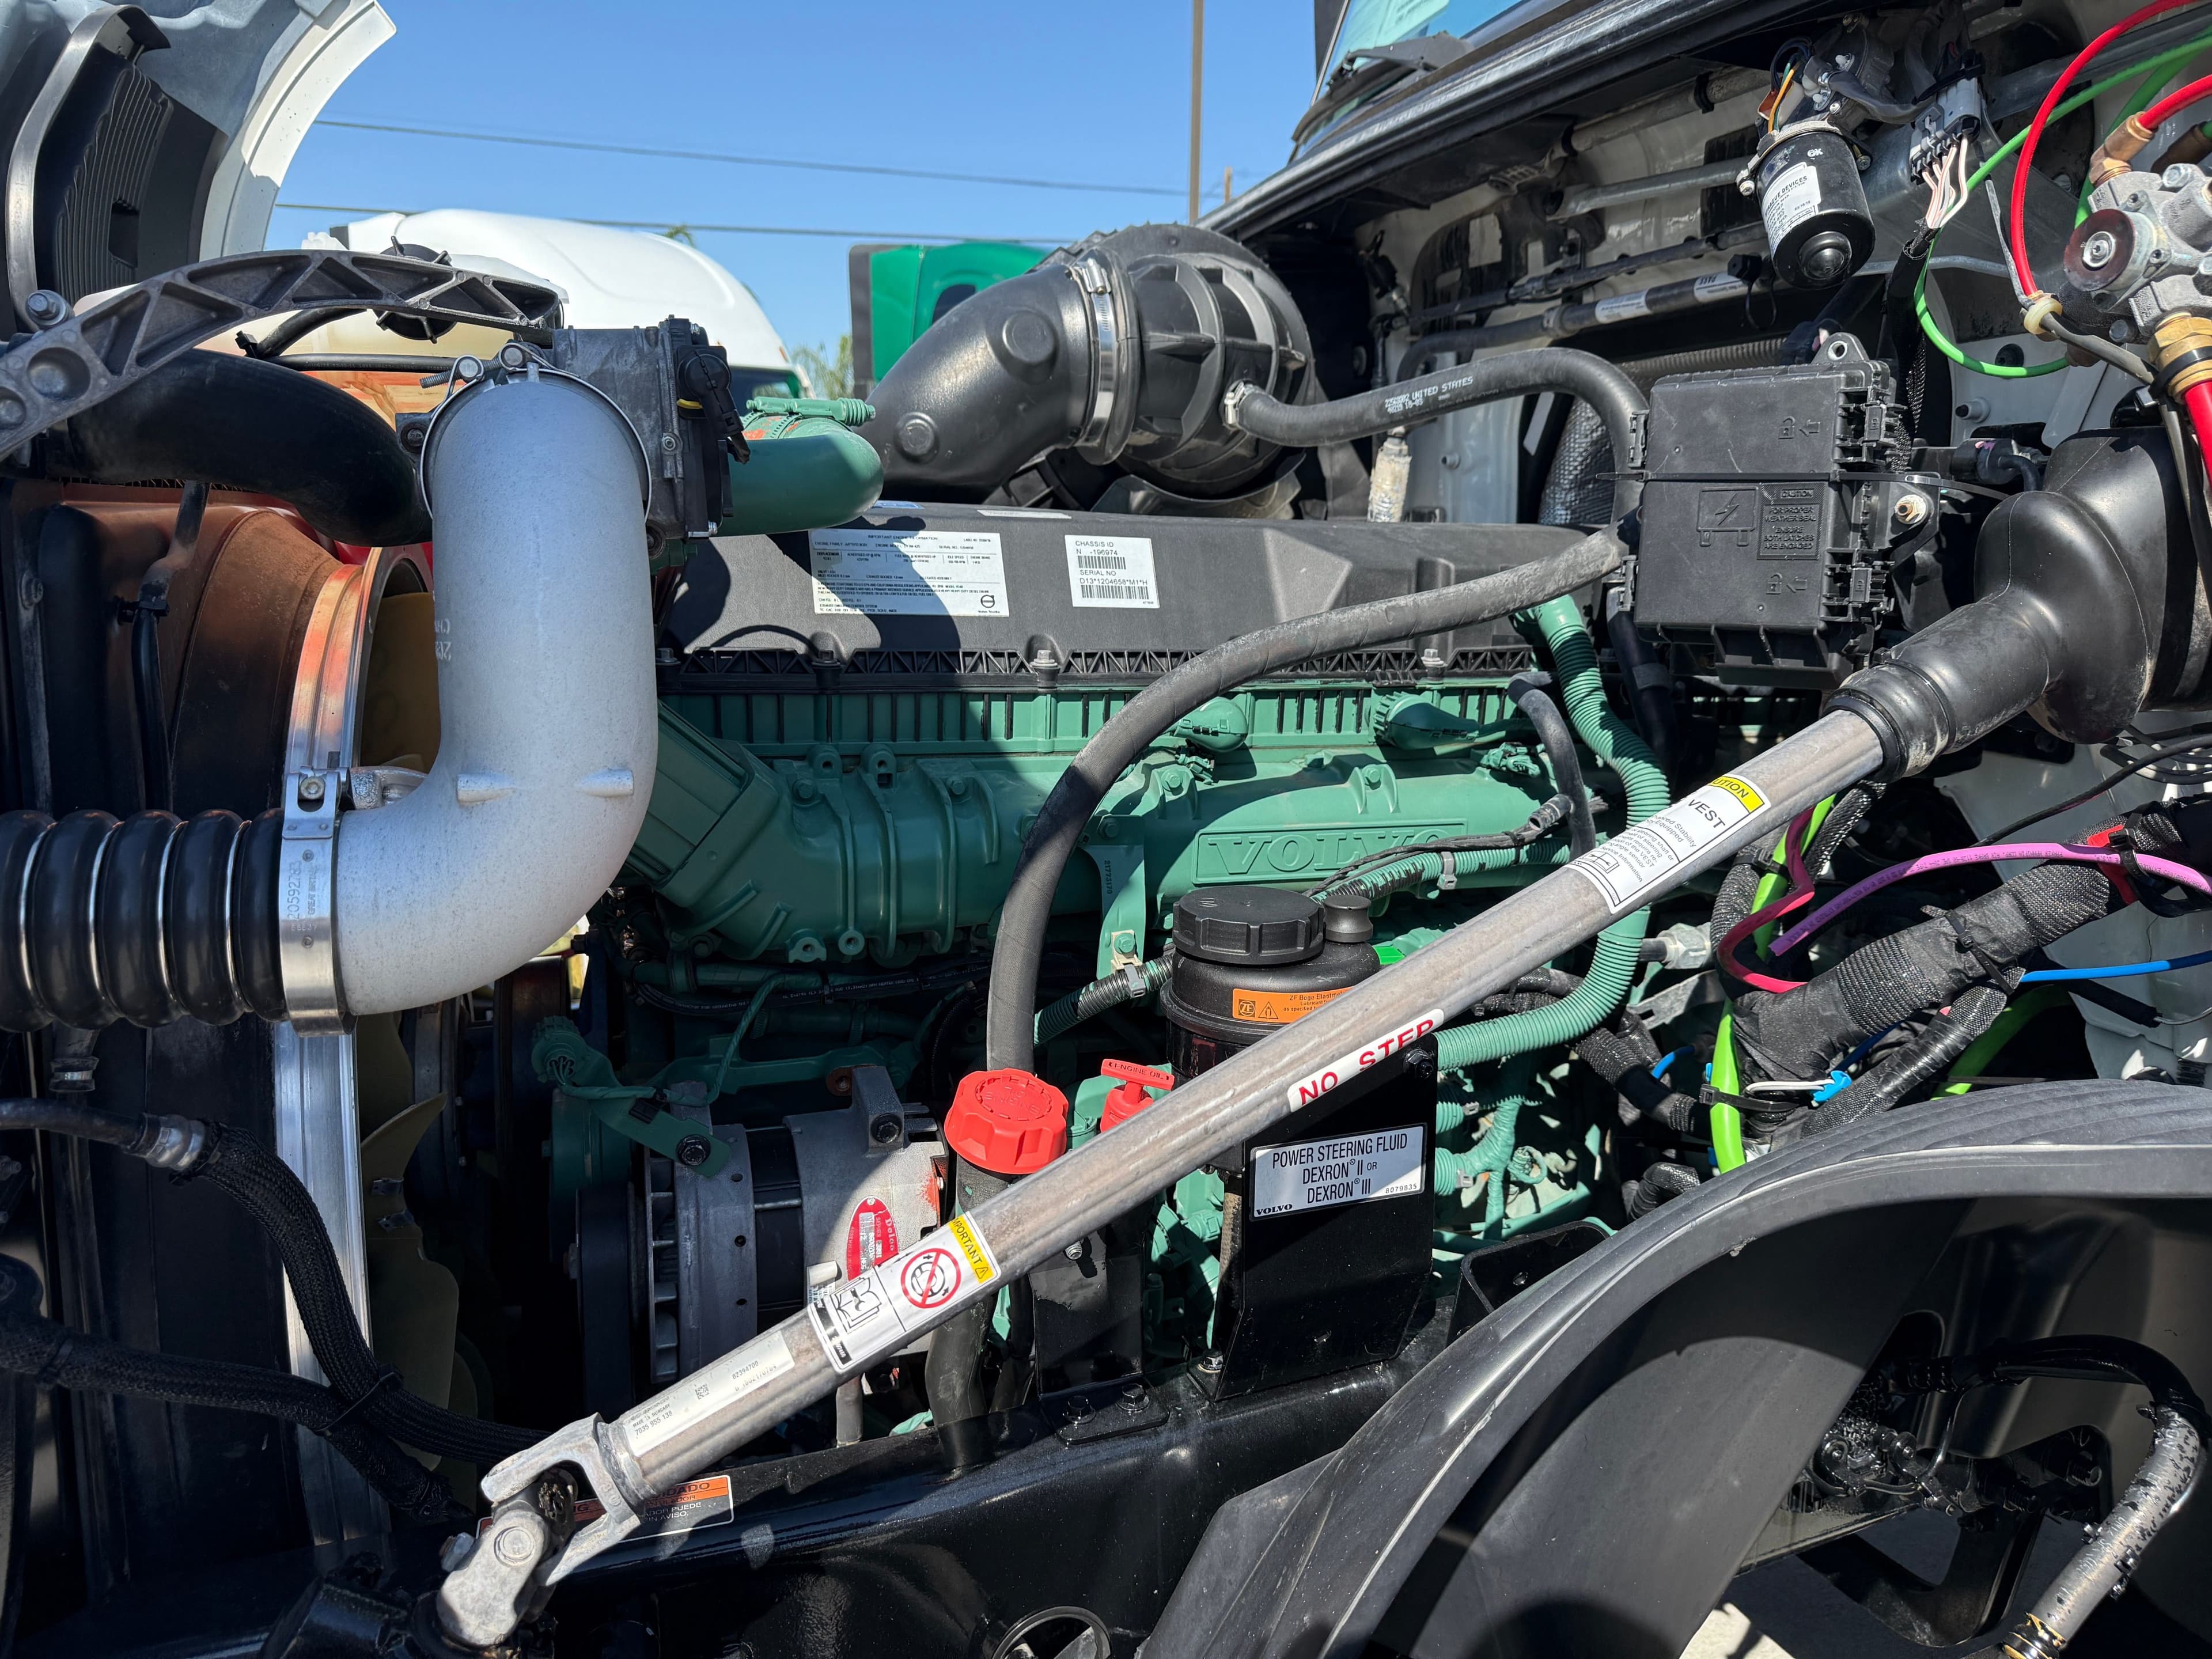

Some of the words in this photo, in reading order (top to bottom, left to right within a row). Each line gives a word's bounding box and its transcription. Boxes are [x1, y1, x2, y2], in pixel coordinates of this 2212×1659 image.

[1782, 176, 1807, 194] DEVICES
[1412, 386, 1438, 399] UNITED
[1442, 376, 1473, 392] STATES
[1713, 778, 1749, 798] UTION
[1688, 799, 1726, 829] VEST
[1675, 824, 1696, 847] Stability
[1643, 839, 1662, 858] steering
[1657, 841, 1669, 854] shaft
[1619, 854, 1643, 882] Information
[1628, 852, 1646, 868] sensor
[1640, 851, 1655, 868] VEST
[1242, 1003, 1252, 1012] ZF
[1299, 1071, 1338, 1105] NO
[1359, 1019, 1434, 1071] STEP
[1115, 1063, 1147, 1075] ENGINE
[1150, 1071, 1164, 1080] OIL
[1272, 1149, 1313, 1169] POWER
[1318, 1138, 1373, 1162] STEERING
[1376, 1133, 1407, 1154] FLUID
[1357, 1160, 1363, 1176] II
[1367, 1161, 1377, 1171] OR
[1361, 1179, 1370, 1194] III
[1385, 1183, 1418, 1194] 8079835
[1256, 1203, 1293, 1216] VOLVO
[652, 1403, 671, 1416] HUNGARY
[635, 1423, 649, 1436] 7035
[650, 1416, 661, 1429] 955
[672, 1502, 702, 1512] PUEDE
